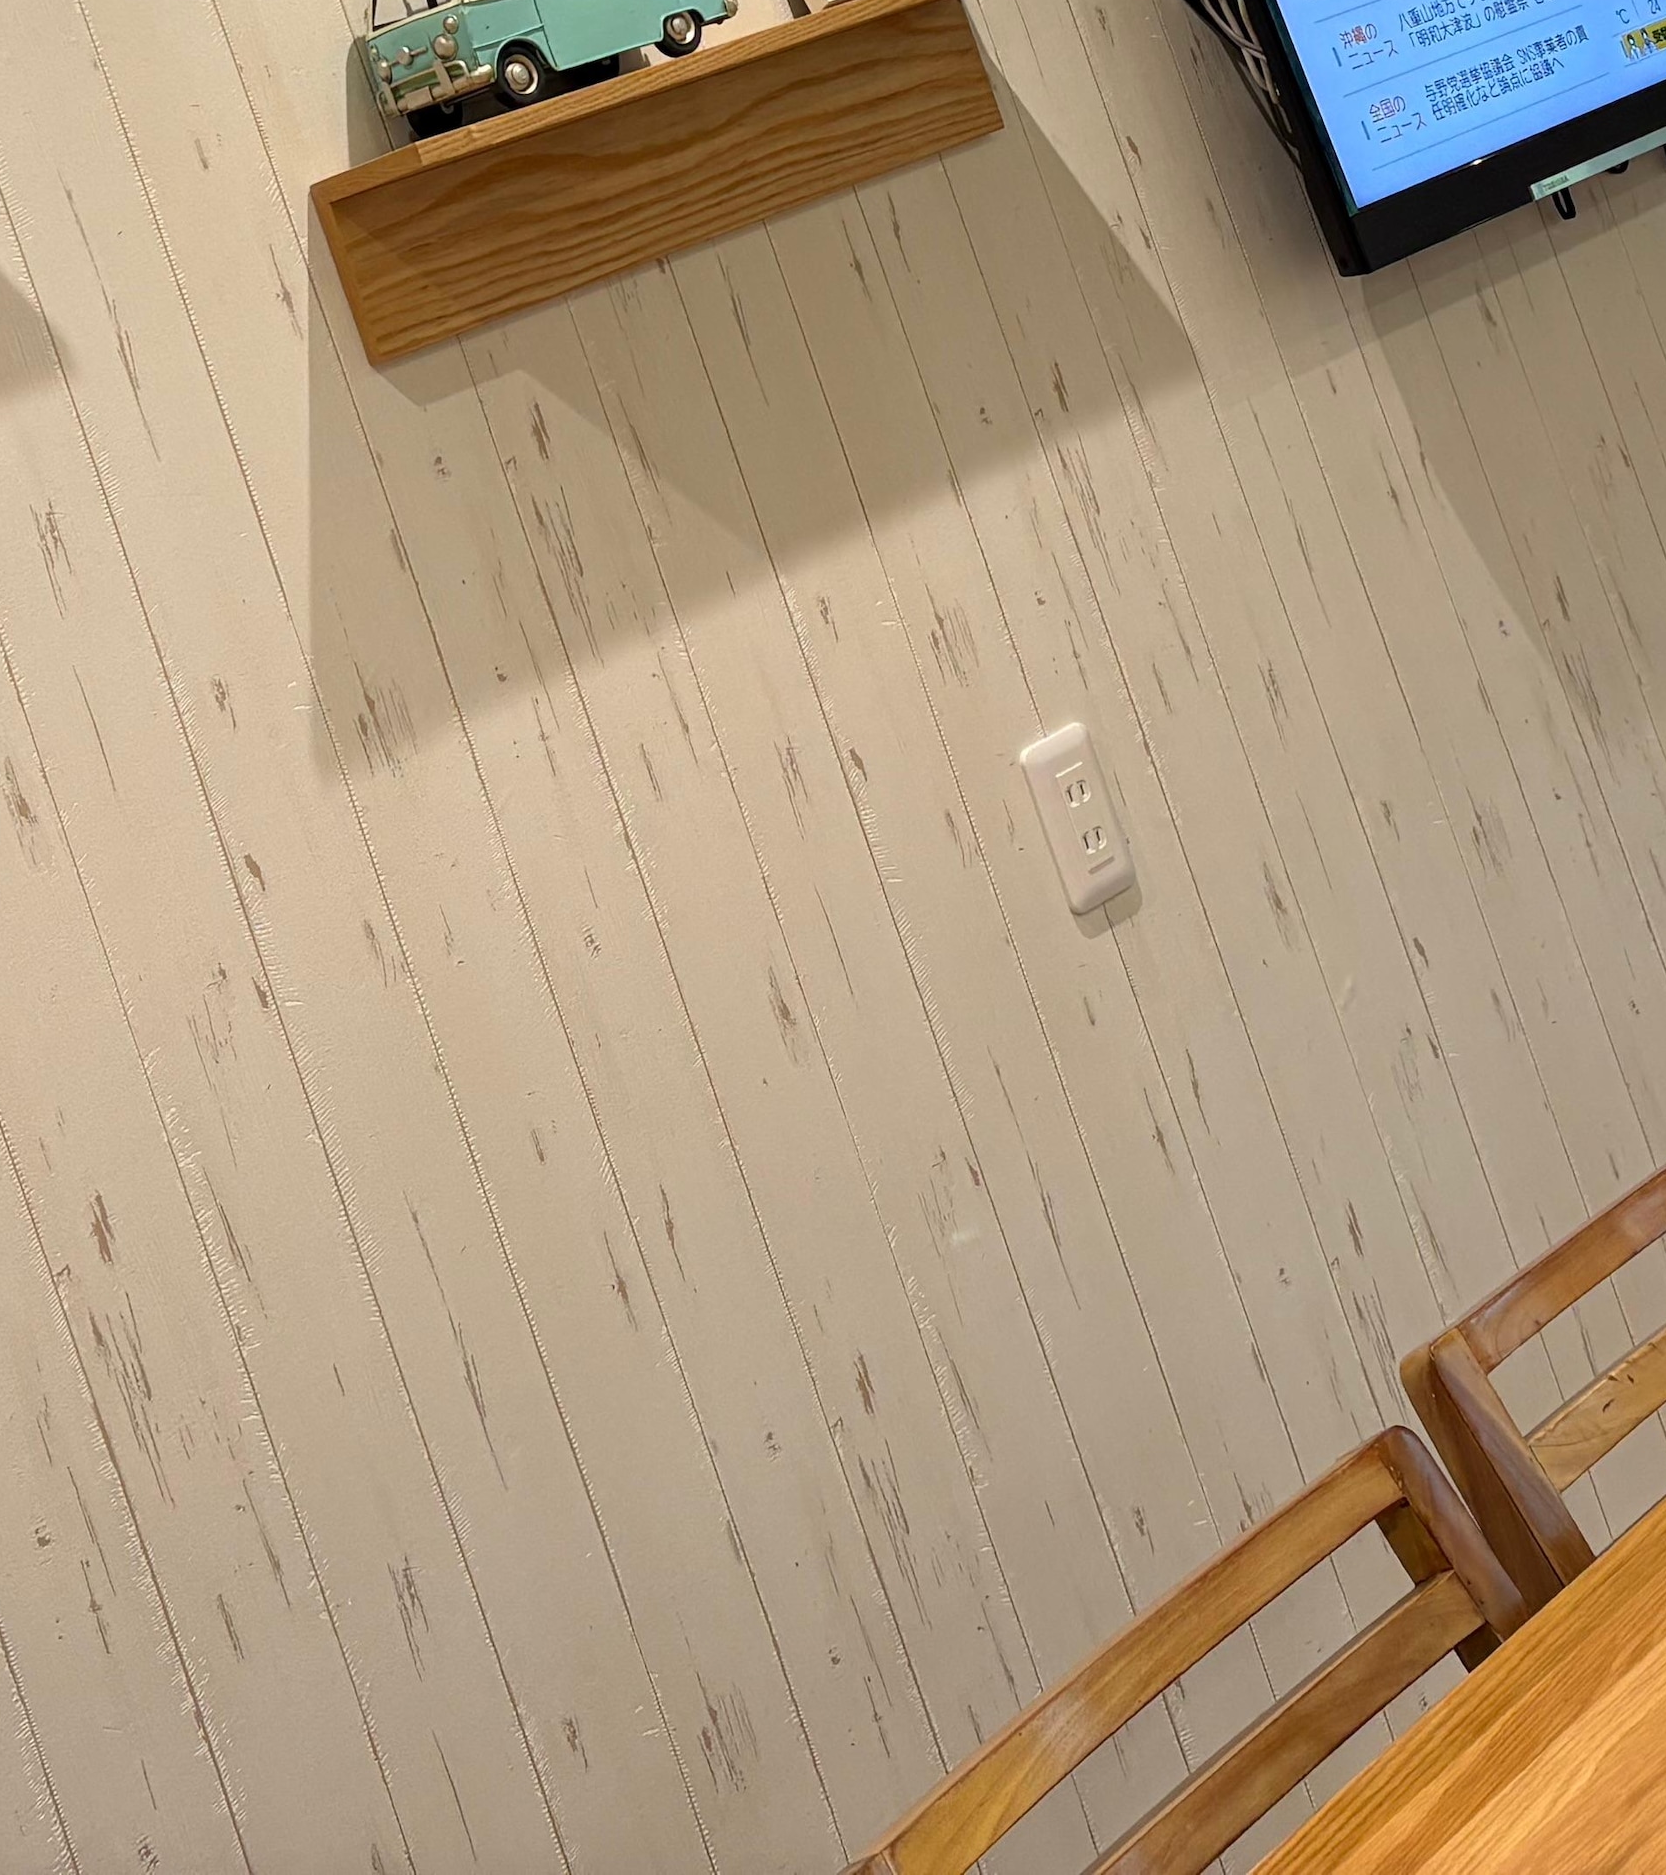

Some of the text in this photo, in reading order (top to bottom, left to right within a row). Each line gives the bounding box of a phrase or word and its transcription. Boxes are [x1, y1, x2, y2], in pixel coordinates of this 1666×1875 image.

[1338, 23, 1378, 50] 沖縄の
[1347, 39, 1399, 71] ニュース
[1424, 53, 1516, 103] 与野党選挙協議会
[1369, 95, 1406, 124] 全国の
[1376, 111, 1428, 144] ニュース
